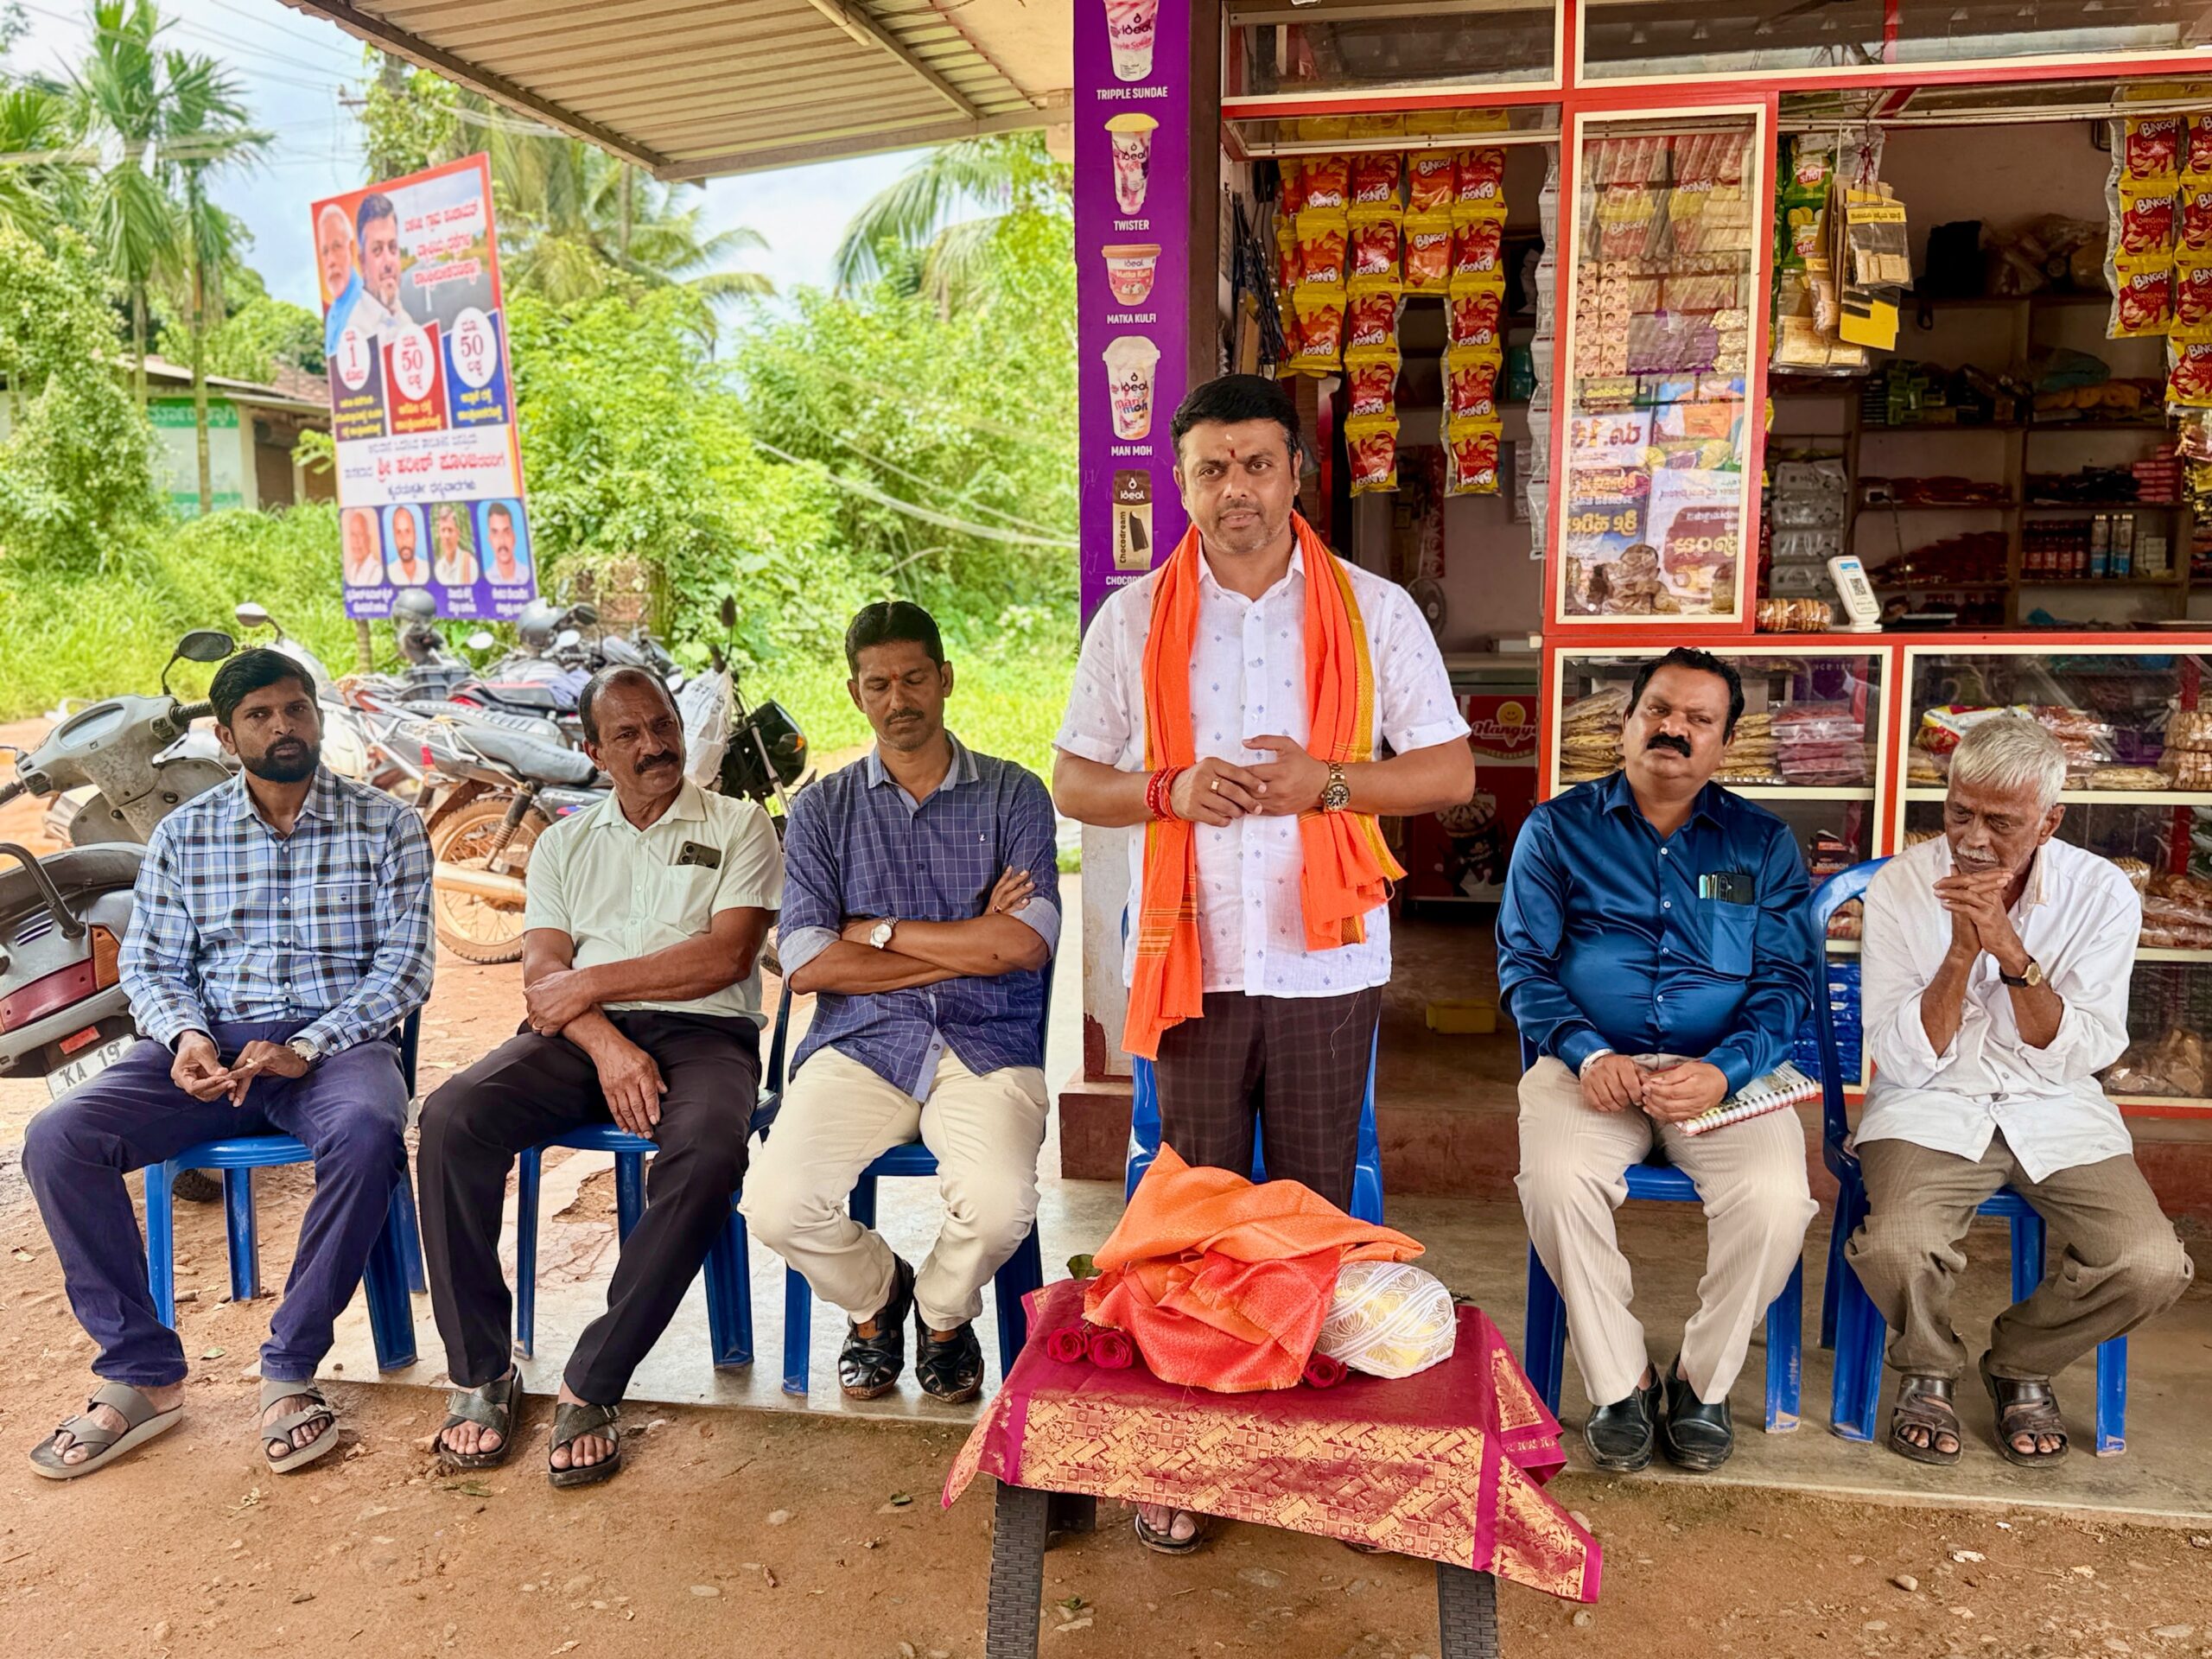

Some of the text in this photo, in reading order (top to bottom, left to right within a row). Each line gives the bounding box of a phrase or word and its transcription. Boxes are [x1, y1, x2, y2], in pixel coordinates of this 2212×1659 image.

[1096, 86, 1168, 100] TRIPPLE SUNDAE
[2140, 118, 2176, 137] BINGO!
[1419, 157, 1452, 175] BINGO!
[2136, 194, 2172, 214] BINGO!
[1113, 219, 1149, 232] TWISTER
[1414, 231, 1448, 251] BINGO!
[2133, 269, 2169, 290] BINGO!
[1107, 313, 1157, 325] MATKA KULFI
[461, 334, 484, 357] 50
[1458, 328, 1491, 347] BINGO!
[349, 344, 356, 367] 1
[402, 349, 423, 372] 50
[1458, 399, 1491, 419] BINGO!
[1111, 445, 1153, 456] MAN MOH
[1105, 575, 1143, 586] CHOCOD
[63, 1042, 120, 1087] KA 19
